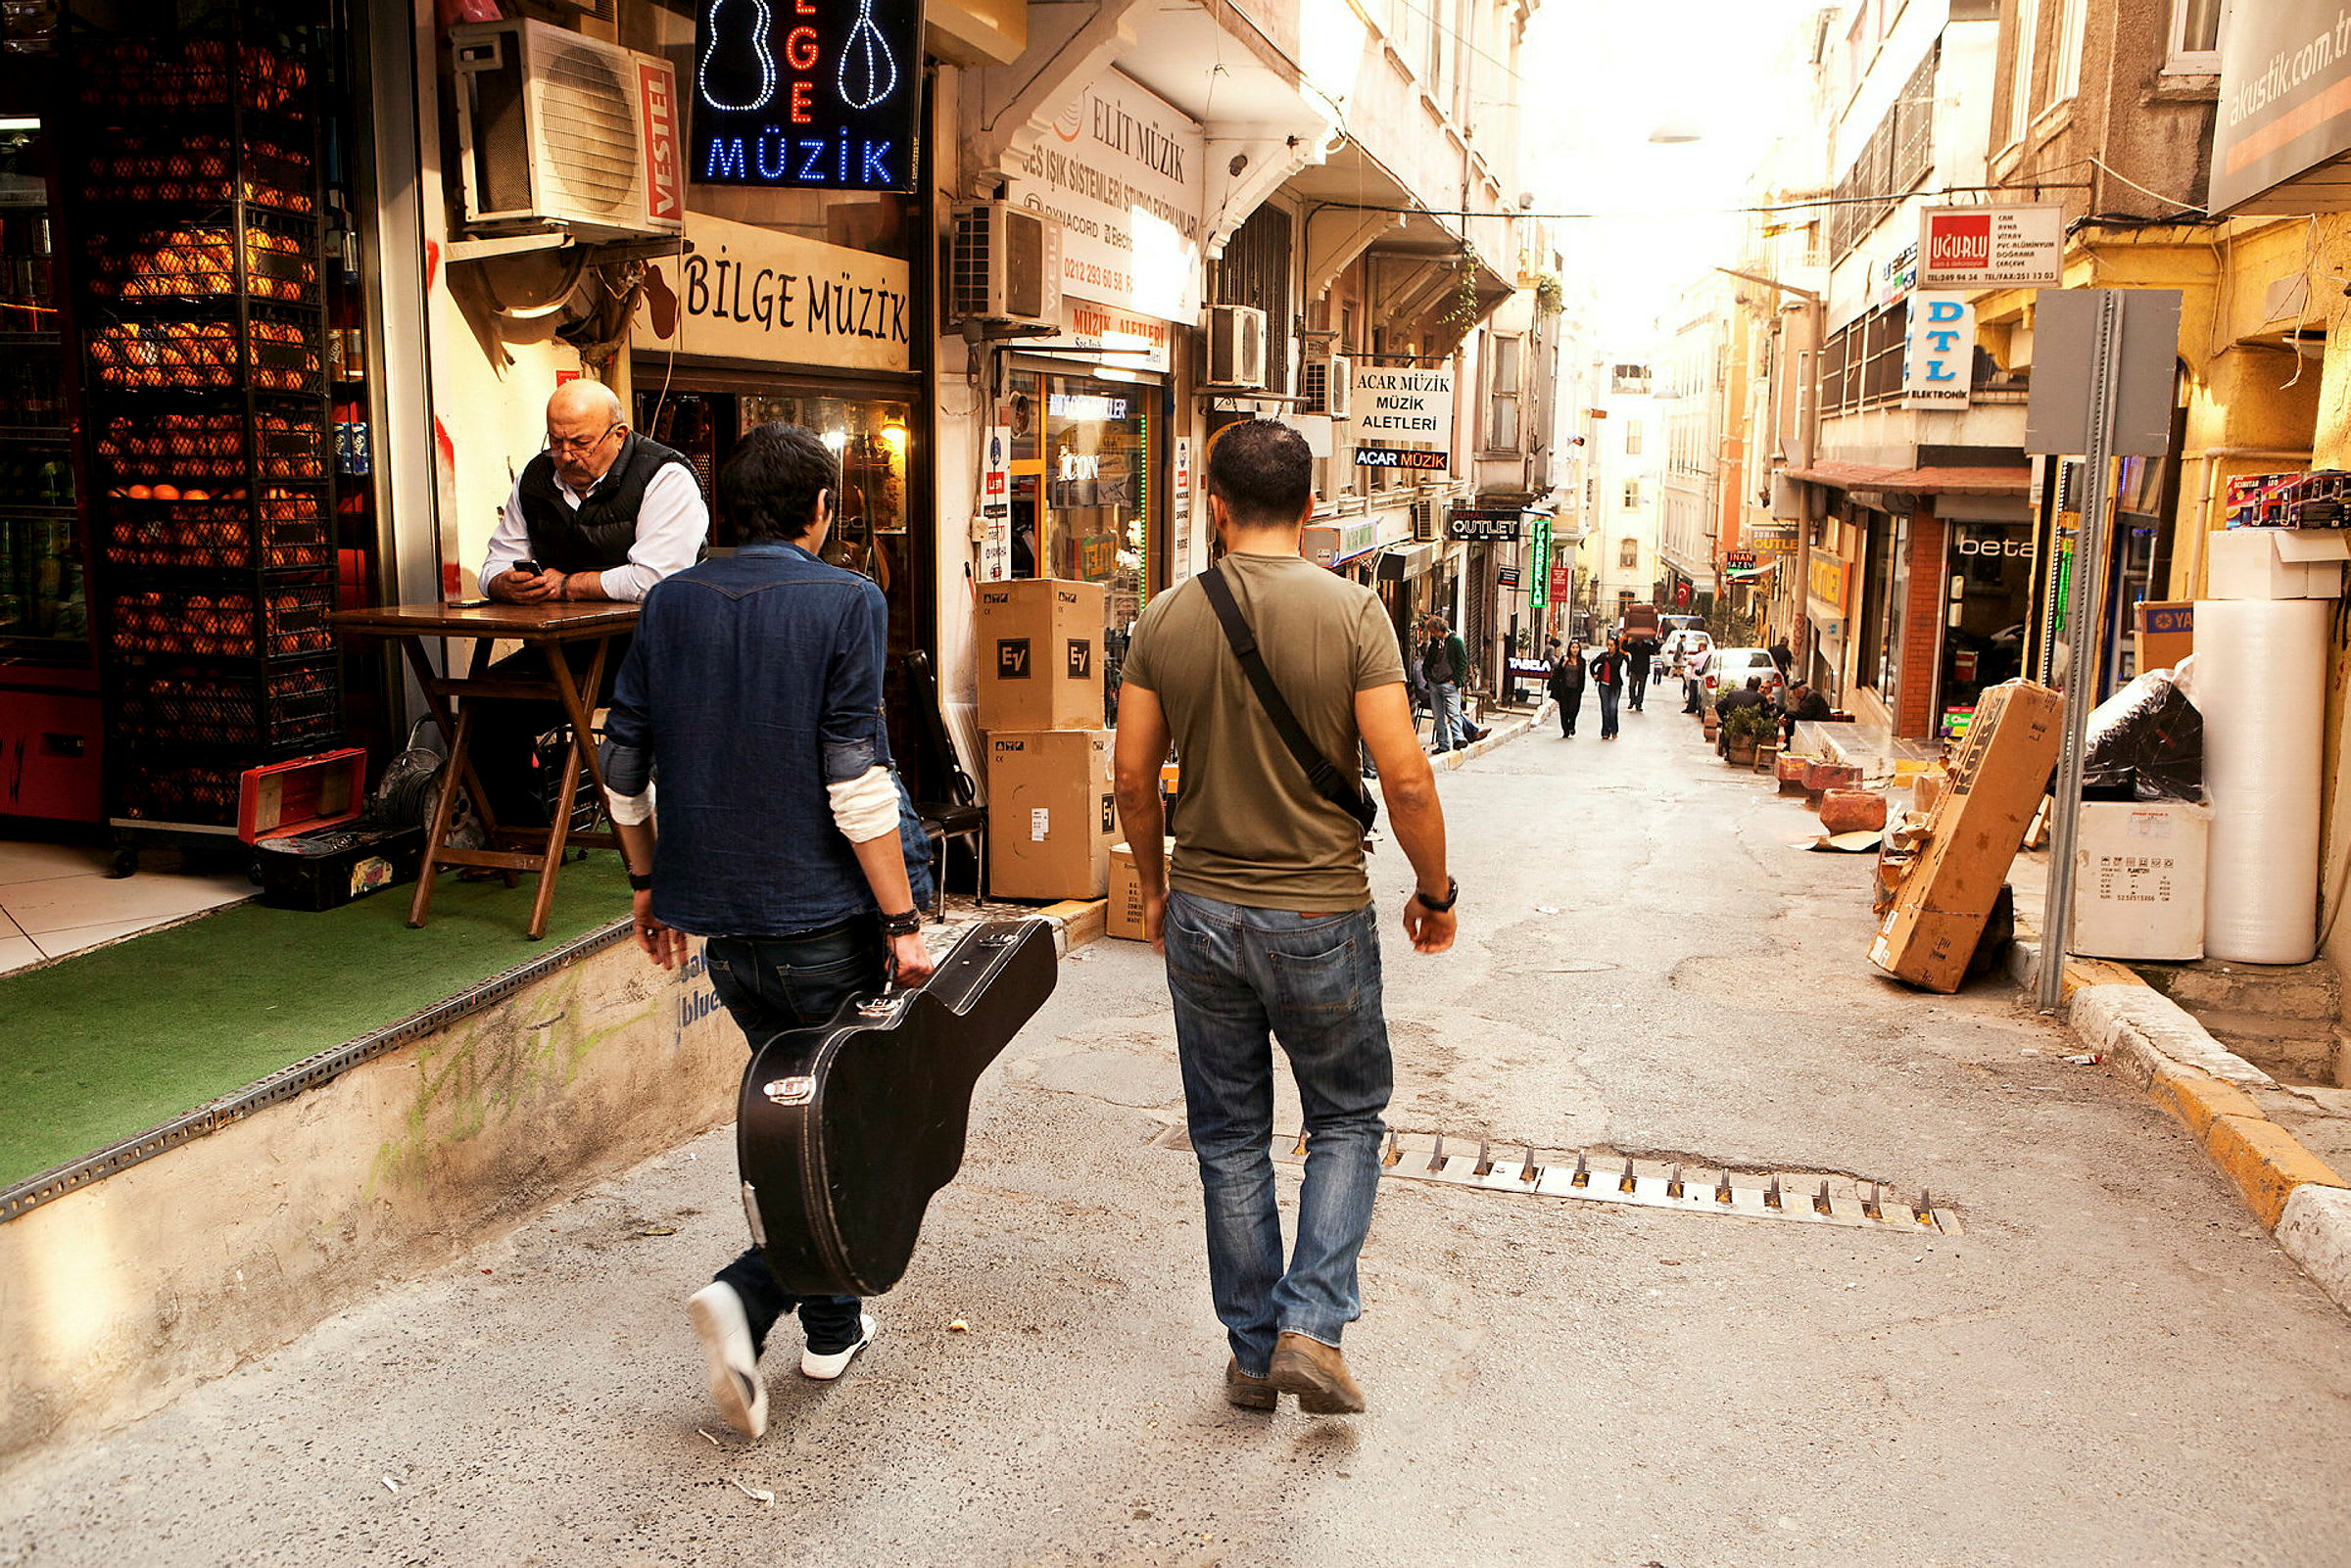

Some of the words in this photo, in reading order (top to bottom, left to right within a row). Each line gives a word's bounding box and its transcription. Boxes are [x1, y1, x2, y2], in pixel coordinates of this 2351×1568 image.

[2230, 9, 2351, 127] akustik.com.tr
[648, 72, 674, 214] VESTEL
[1092, 95, 1133, 157] ELİT
[1136, 120, 1185, 184] MÜZİK
[704, 124, 892, 185] MÜZİK
[1046, 148, 1067, 192] IŞIK
[1069, 152, 1123, 210] SİSTEMLERİ
[1933, 233, 1989, 259] UĞURLU
[1065, 258, 1085, 282] 0212
[1086, 263, 1101, 286] 293
[1114, 271, 1124, 292] 58
[684, 244, 797, 332] BİLGE
[807, 271, 909, 345] MÜZİK
[1073, 305, 1111, 338] MÜZİK
[1927, 301, 1965, 381] DTL
[1357, 374, 1397, 390] ACAR
[1400, 373, 1451, 392] MÜZİK
[1911, 389, 1967, 400] ELEKTRONİK
[1376, 395, 1424, 410] MÜZİK
[1362, 415, 1437, 431] ALETLERİ
[1357, 451, 1398, 466] ACAR
[1400, 452, 1446, 468] MÜZİK
[1452, 520, 1517, 535] OUTLET
[1753, 539, 1799, 549] OUTLE
[1959, 534, 2034, 557] beta
[1002, 646, 1027, 672] EV
[1070, 645, 1088, 672] EV
[1509, 657, 1552, 672] TABELA
[683, 990, 724, 1027] blue
